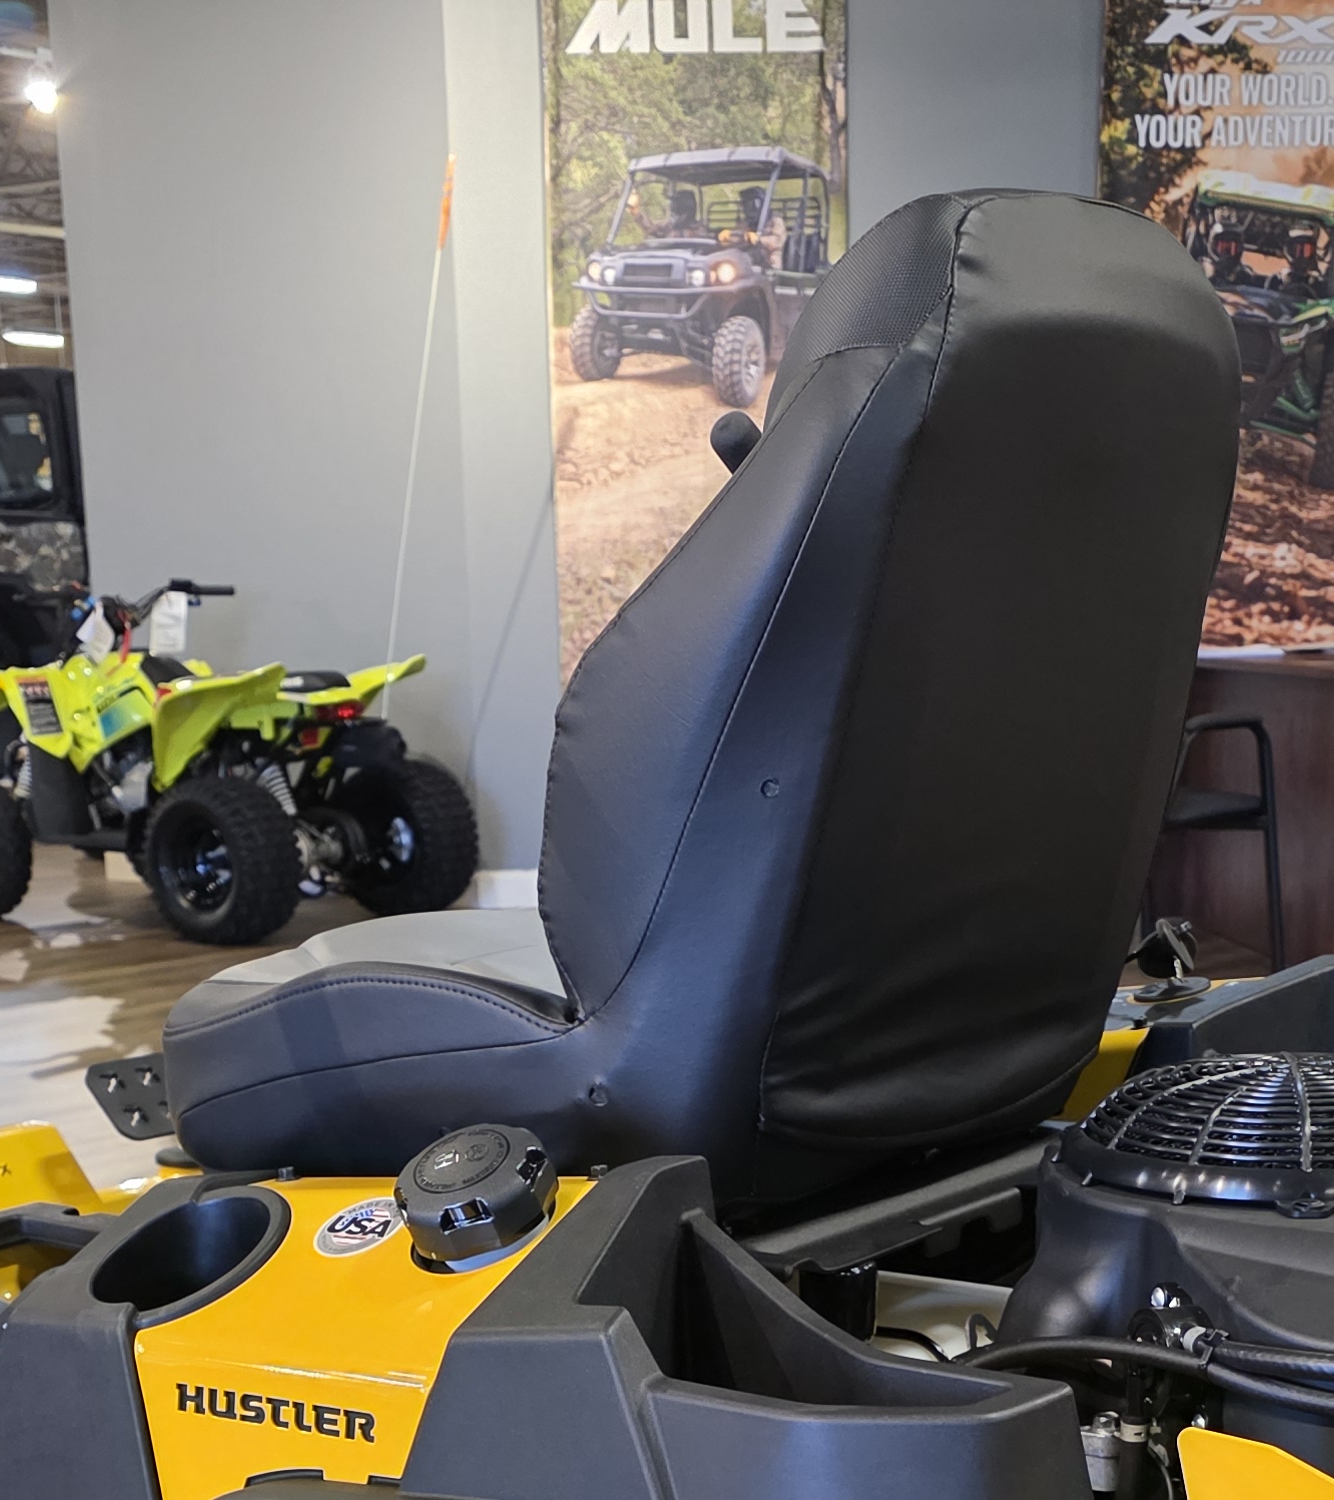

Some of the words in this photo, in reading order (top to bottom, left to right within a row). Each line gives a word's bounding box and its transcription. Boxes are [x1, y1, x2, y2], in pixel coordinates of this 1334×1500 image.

[565, 0, 825, 54] MULE
[1164, 74, 1231, 107] YOUR
[1241, 74, 1334, 106] WORLD.
[1135, 114, 1202, 149] YOUR
[327, 1215, 392, 1237] USA
[176, 1383, 376, 1443] HUSTLER
